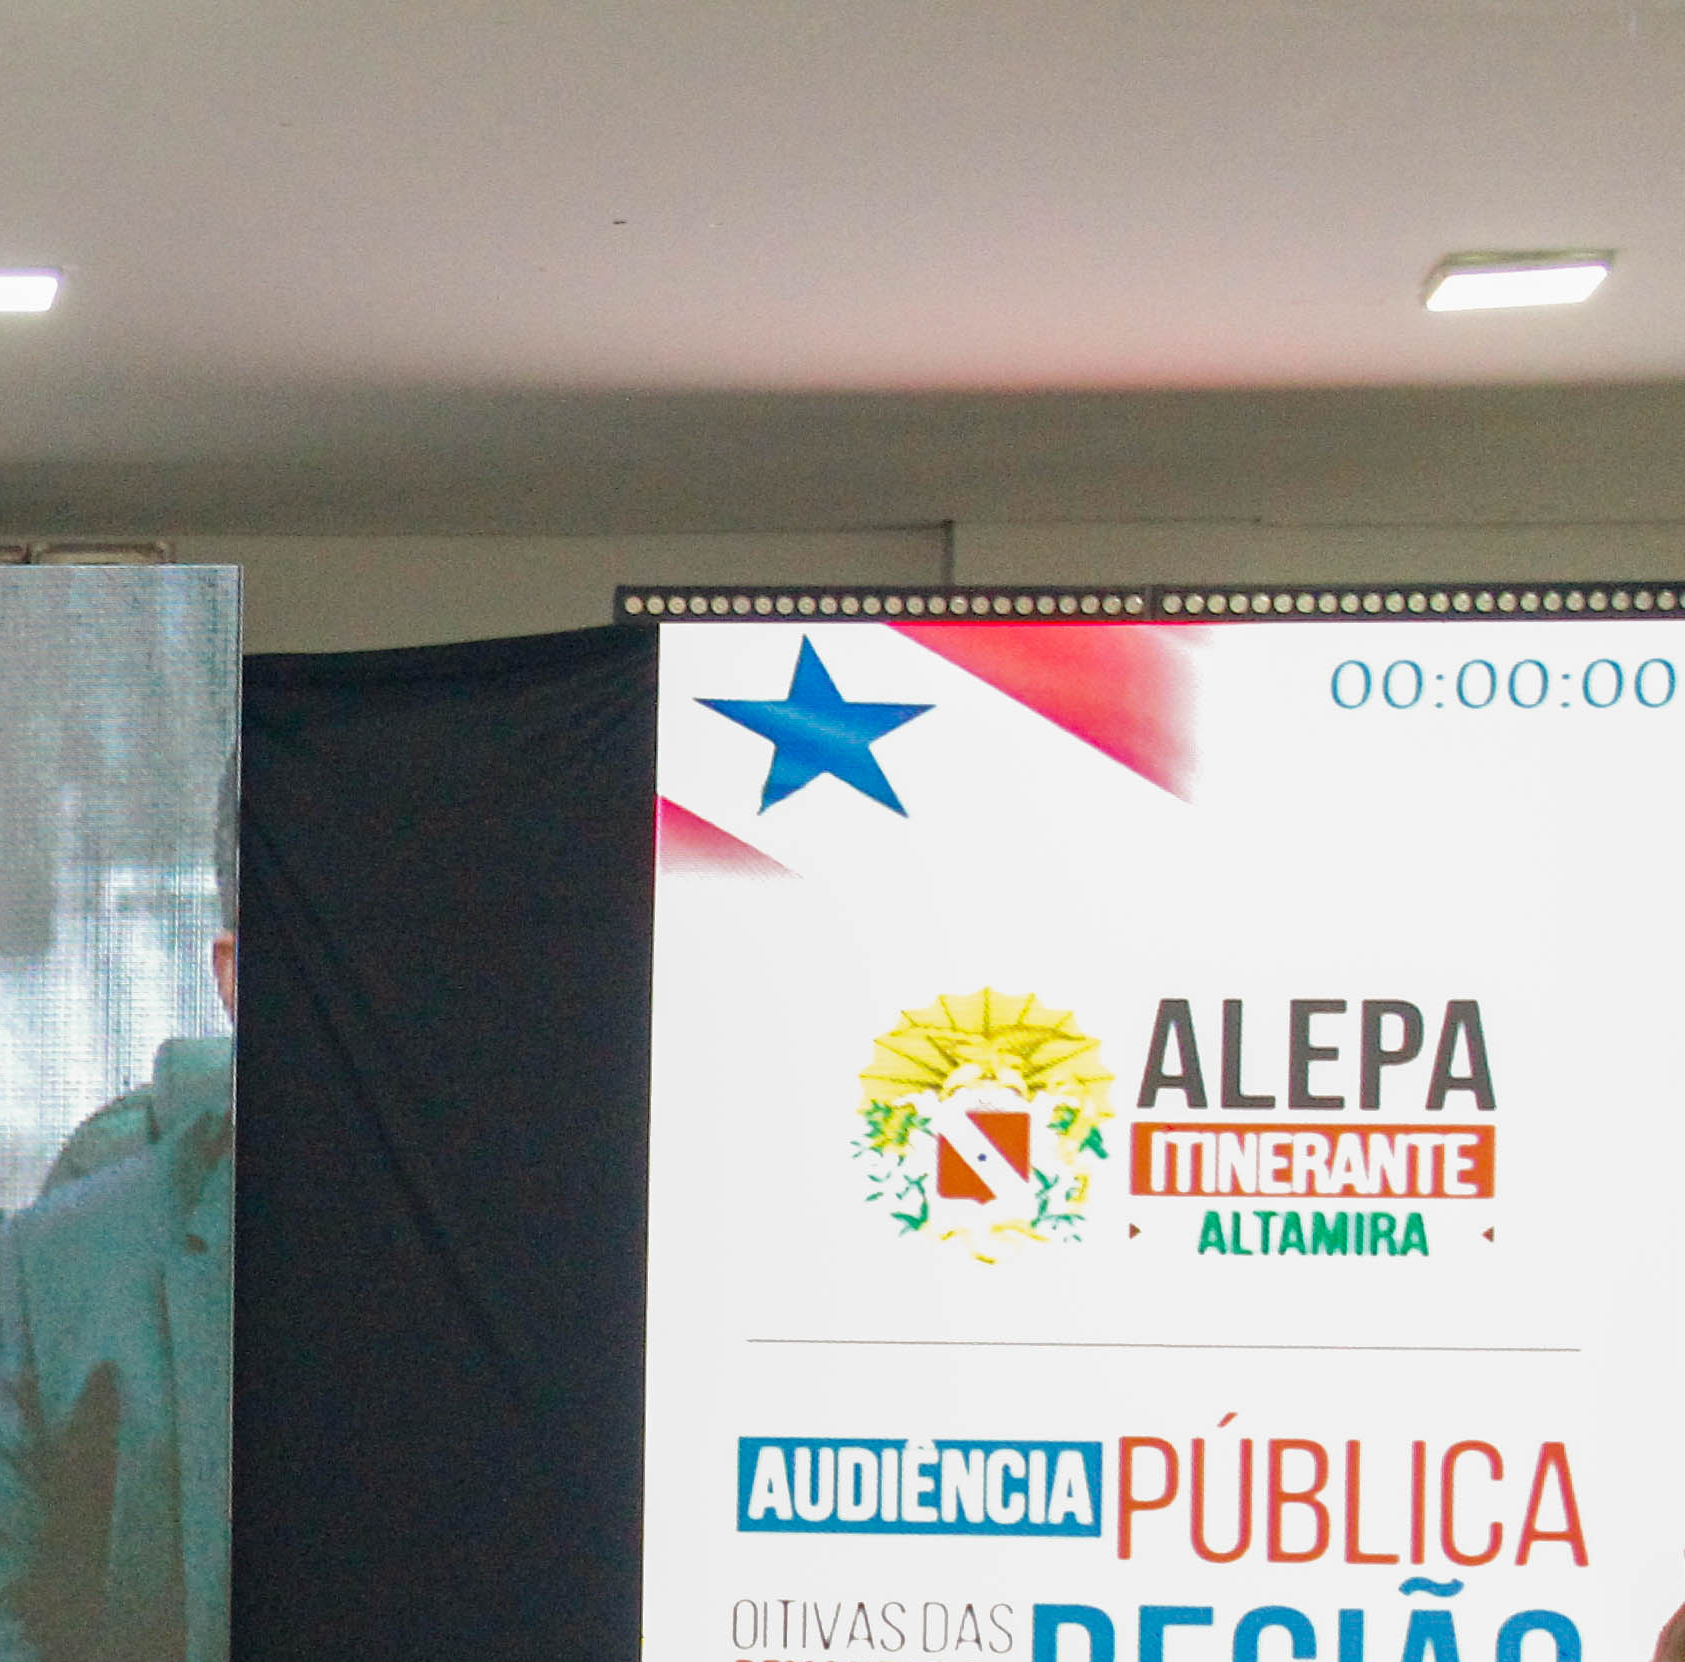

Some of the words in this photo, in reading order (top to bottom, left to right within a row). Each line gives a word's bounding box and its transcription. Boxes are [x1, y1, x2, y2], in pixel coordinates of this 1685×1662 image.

[1331, 658, 1676, 709] 00:00:00
[1137, 998, 1496, 1111] ALEPA
[1149, 1130, 1479, 1195] ITINERANTE
[1198, 1210, 1429, 1256] ALTAMIRA
[748, 1438, 1094, 1526] AUDIÊNCIA
[1117, 1412, 1590, 1567] PÚBLICA
[732, 1599, 906, 1652] OITIVAS
[922, 1602, 1013, 1653] DAS
